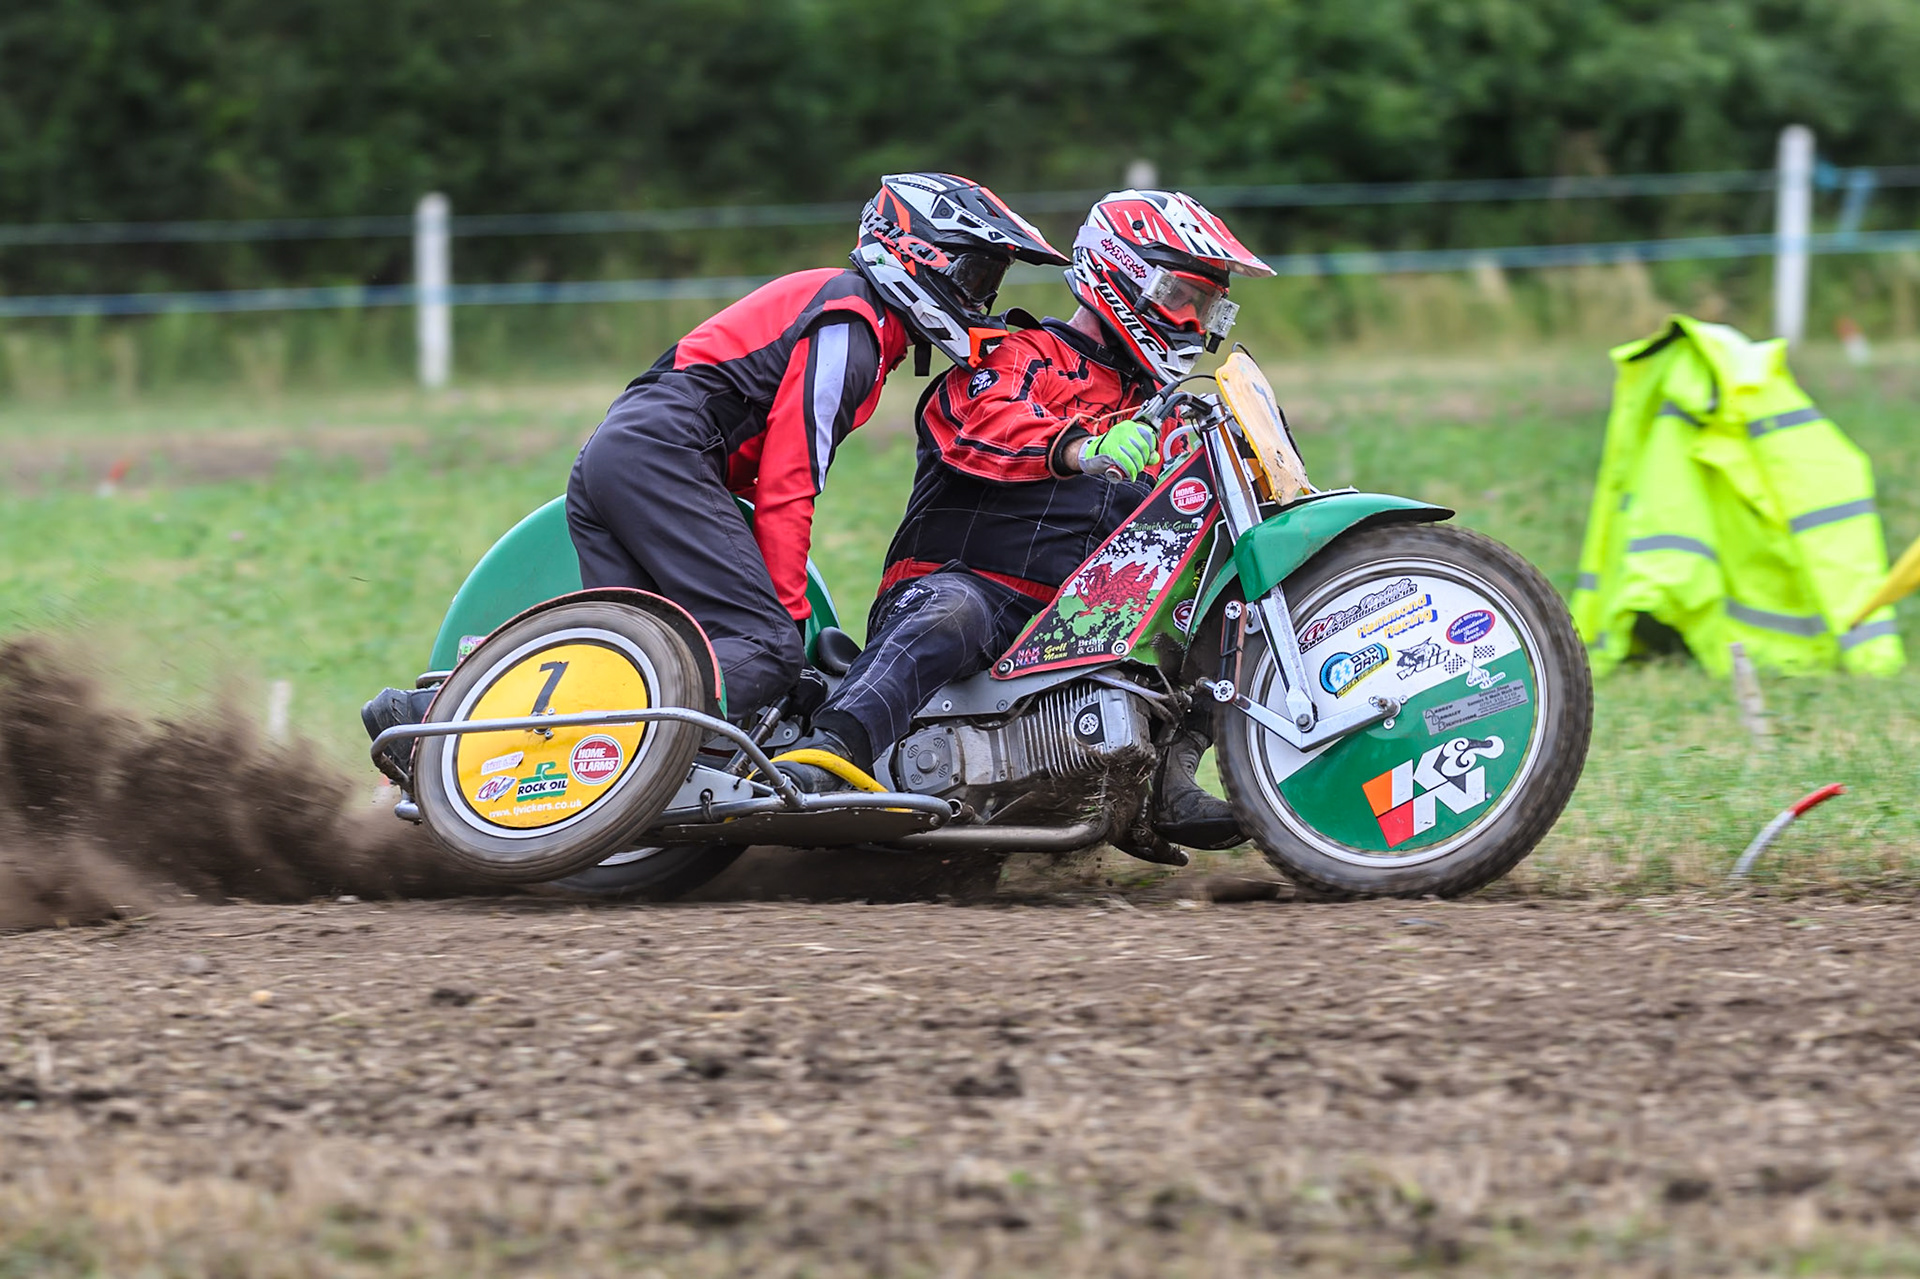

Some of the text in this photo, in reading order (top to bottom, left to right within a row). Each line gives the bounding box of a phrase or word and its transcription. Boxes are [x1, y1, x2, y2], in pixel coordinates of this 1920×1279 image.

[1175, 486, 1196, 498] HOME
[1177, 494, 1205, 507] ALARMS
[1357, 593, 1432, 638] Hammond
[1384, 609, 1438, 638] Racing
[1077, 644, 1104, 655] & Gill
[531, 661, 569, 715] 7
[578, 747, 606, 759] HOME
[576, 760, 616, 773] ALARMS
[517, 780, 567, 795] ROCK OIL
